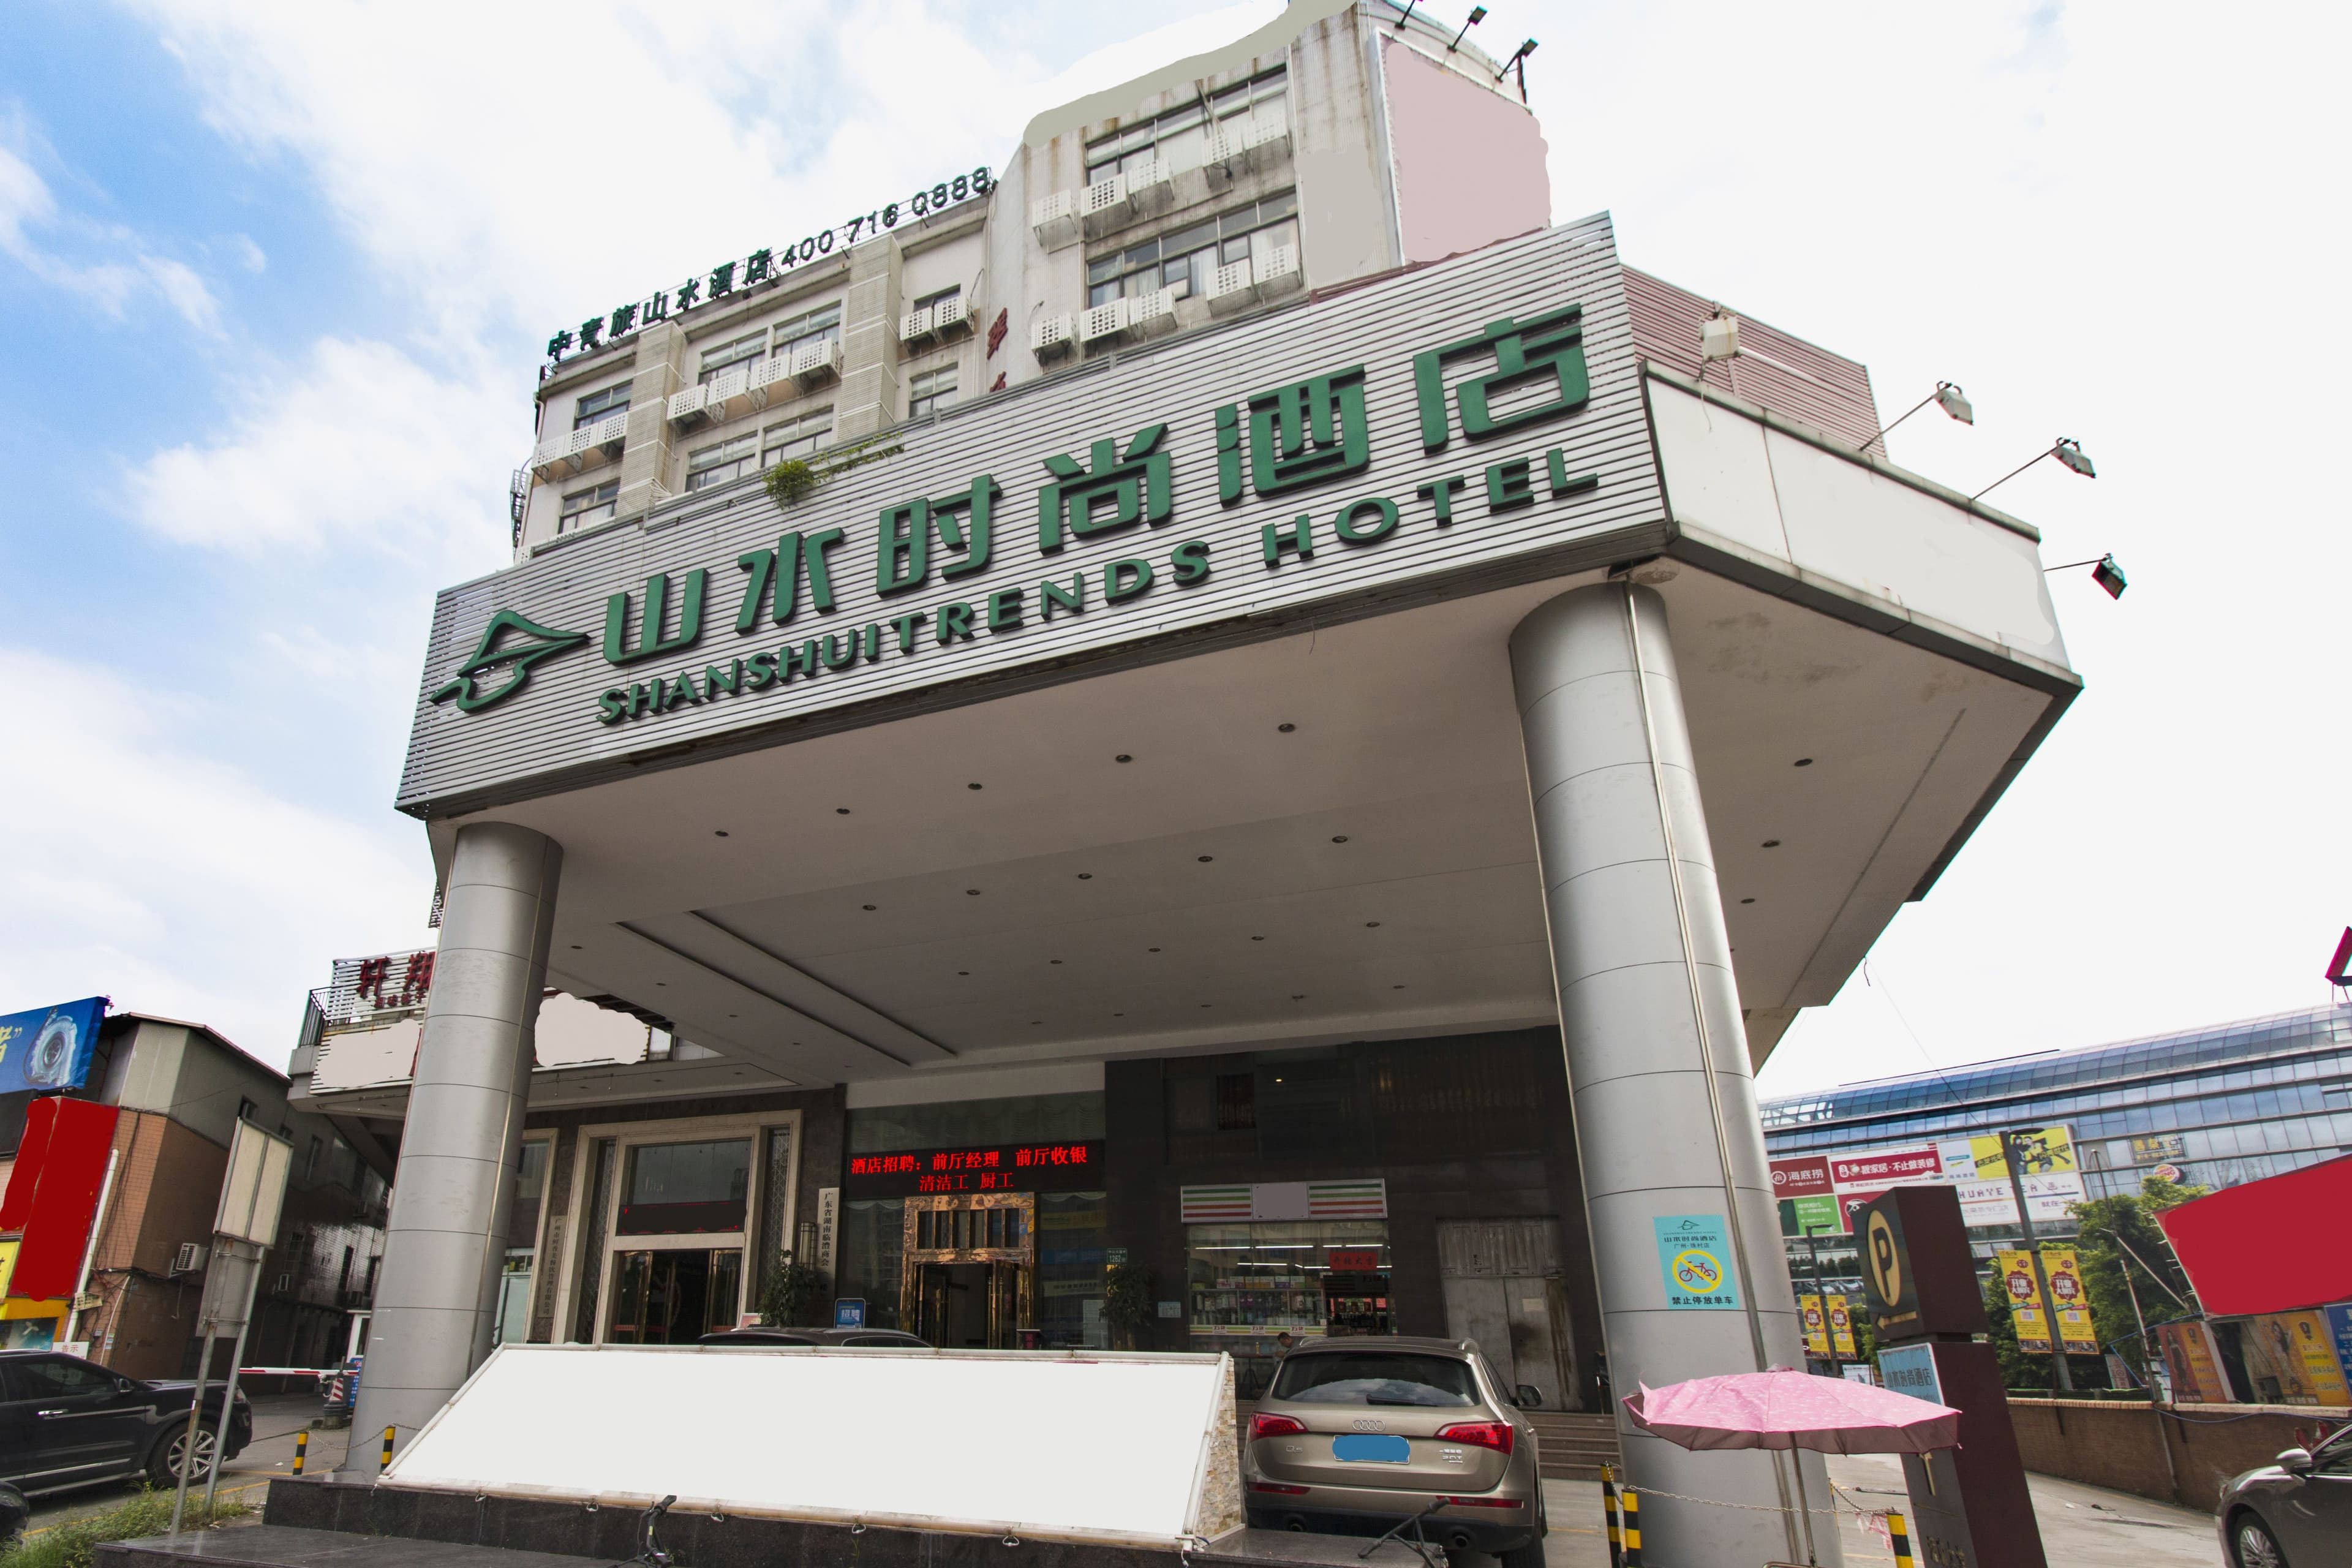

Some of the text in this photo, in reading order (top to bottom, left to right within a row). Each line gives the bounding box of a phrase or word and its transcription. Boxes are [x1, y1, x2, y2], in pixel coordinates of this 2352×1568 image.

[547, 167, 989, 362] 中青旅山水酒店 400 716 0888
[602, 302, 1590, 666] 山水时尚酒店
[1261, 447, 1599, 569] HOTEL
[932, 1151, 1000, 1170] 前厅经理
[1015, 1146, 1087, 1167] 前厅收银
[919, 1172, 1014, 1191] 清洁工 厨工
[1787, 1169, 1824, 1182] 海底捞
[1958, 1187, 2005, 1199] HUAYE
[1872, 1226, 1893, 1298] P
[1672, 1295, 1733, 1305] 禁止停放单车
[61, 1344, 79, 1353] 告示
